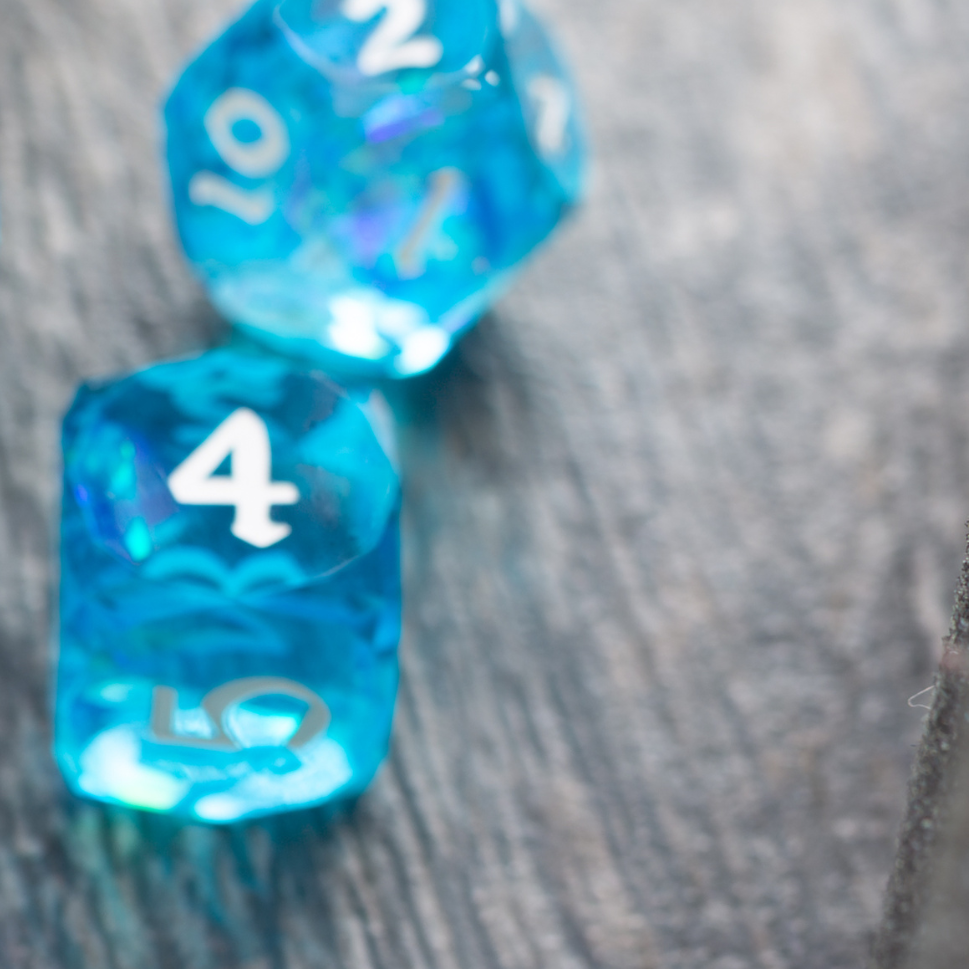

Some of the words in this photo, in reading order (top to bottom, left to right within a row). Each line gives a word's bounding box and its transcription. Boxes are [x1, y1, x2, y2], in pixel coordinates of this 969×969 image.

[341, 0, 443, 76] 2
[188, 87, 291, 226] 10
[167, 406, 300, 549] 4
[150, 675, 331, 750] 5
